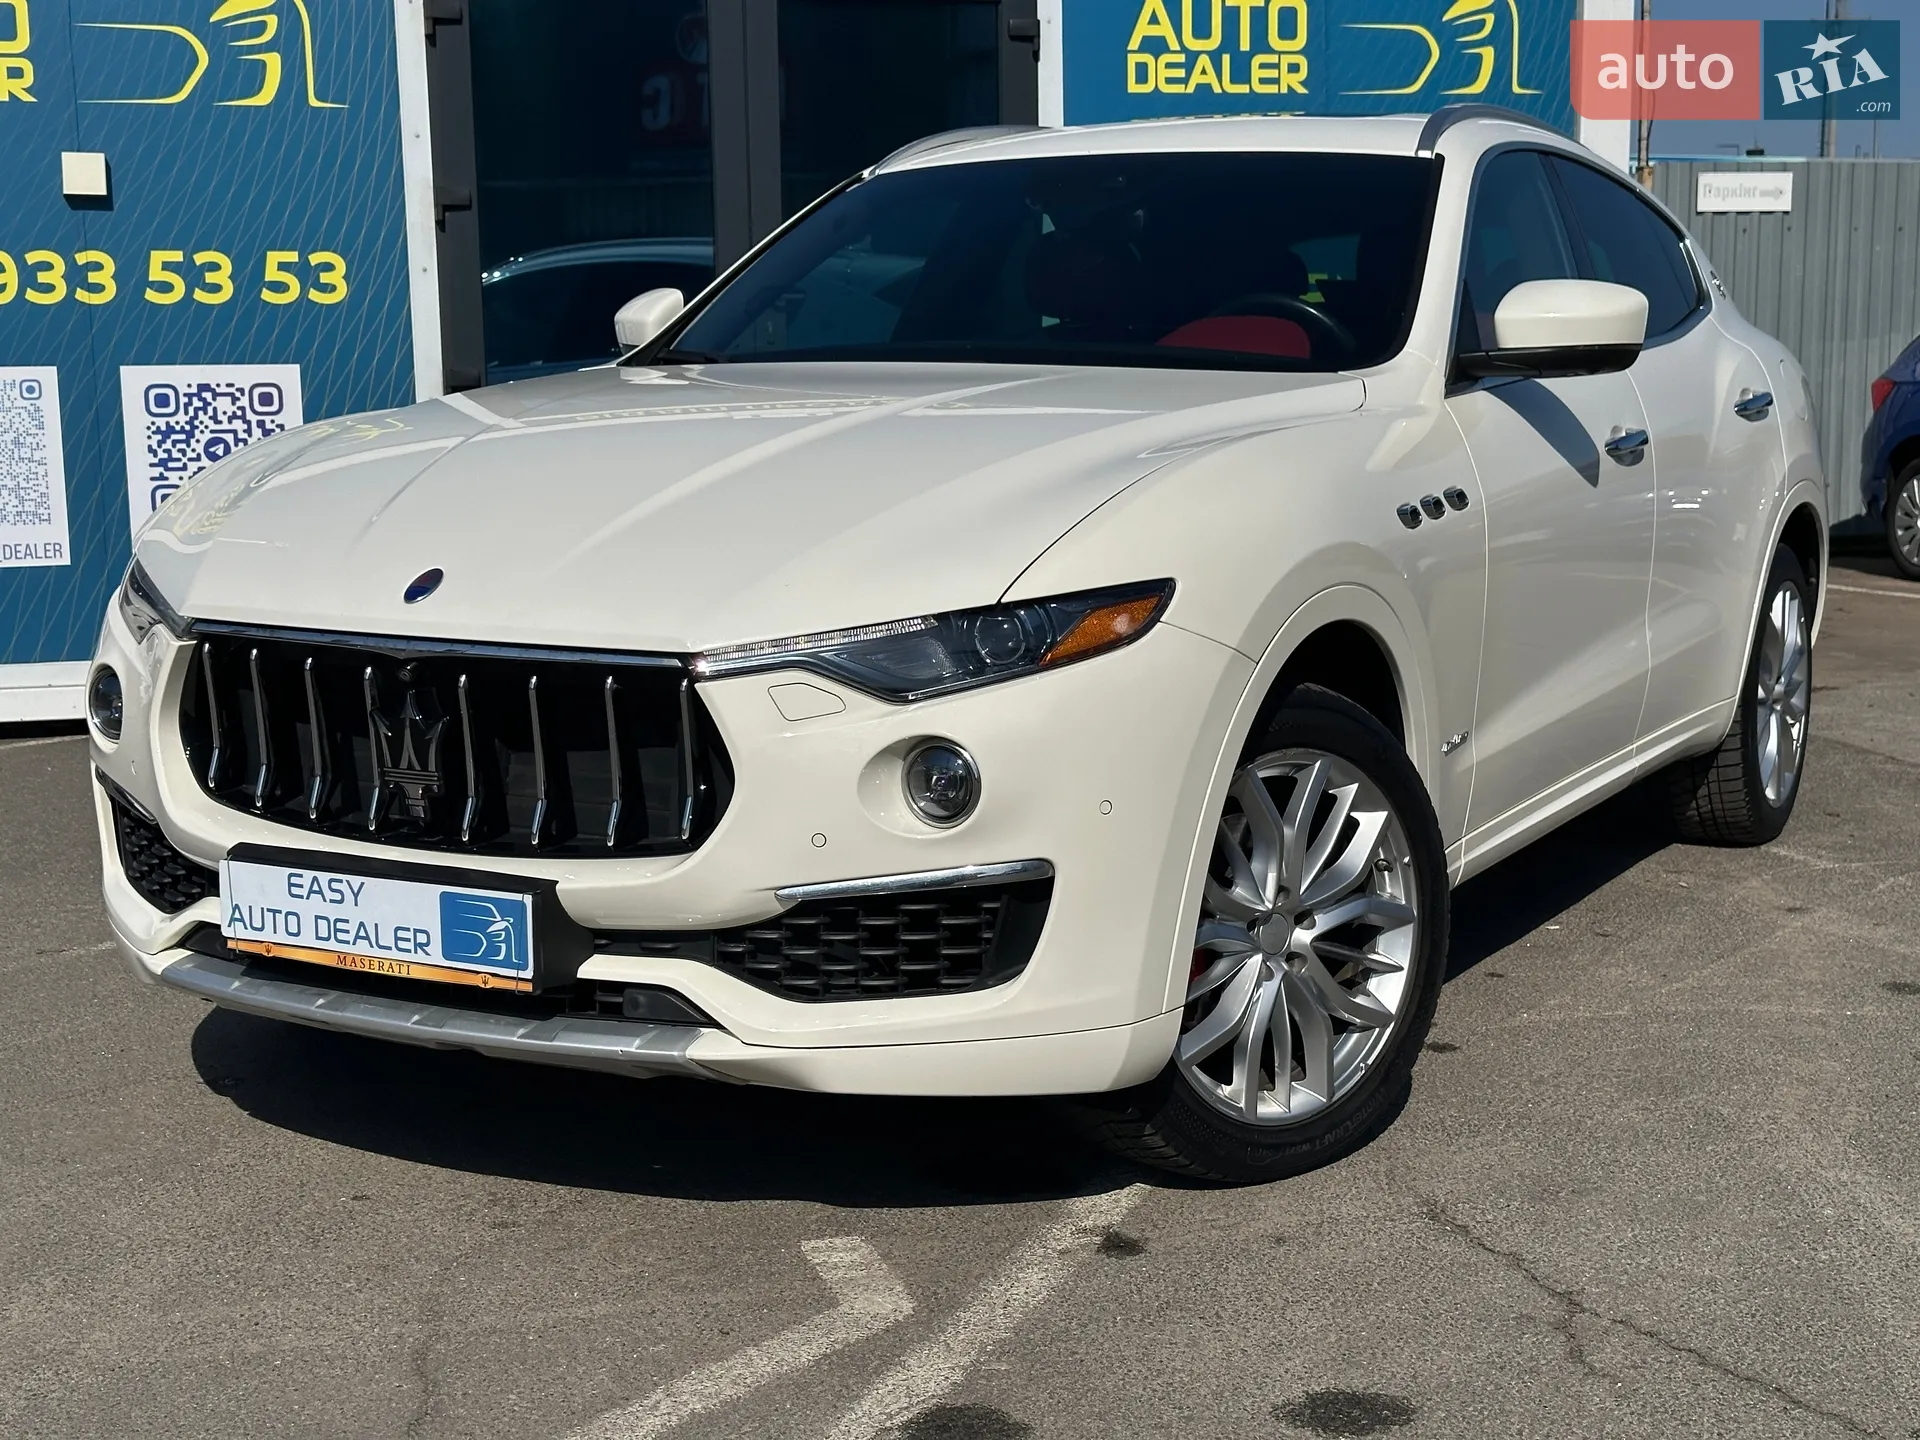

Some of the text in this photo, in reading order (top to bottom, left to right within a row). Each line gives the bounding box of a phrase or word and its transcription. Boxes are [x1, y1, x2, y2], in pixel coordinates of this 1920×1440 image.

[1128, 0, 1308, 52] AUTO
[1128, 54, 1308, 94] DEALER
[144, 250, 234, 305] 53
[260, 250, 348, 305] 53
[0, 542, 63, 562] DEALER
[287, 872, 366, 907] EASY
[227, 903, 432, 957] AUTO DEALER
[336, 954, 411, 976] MASERATI
